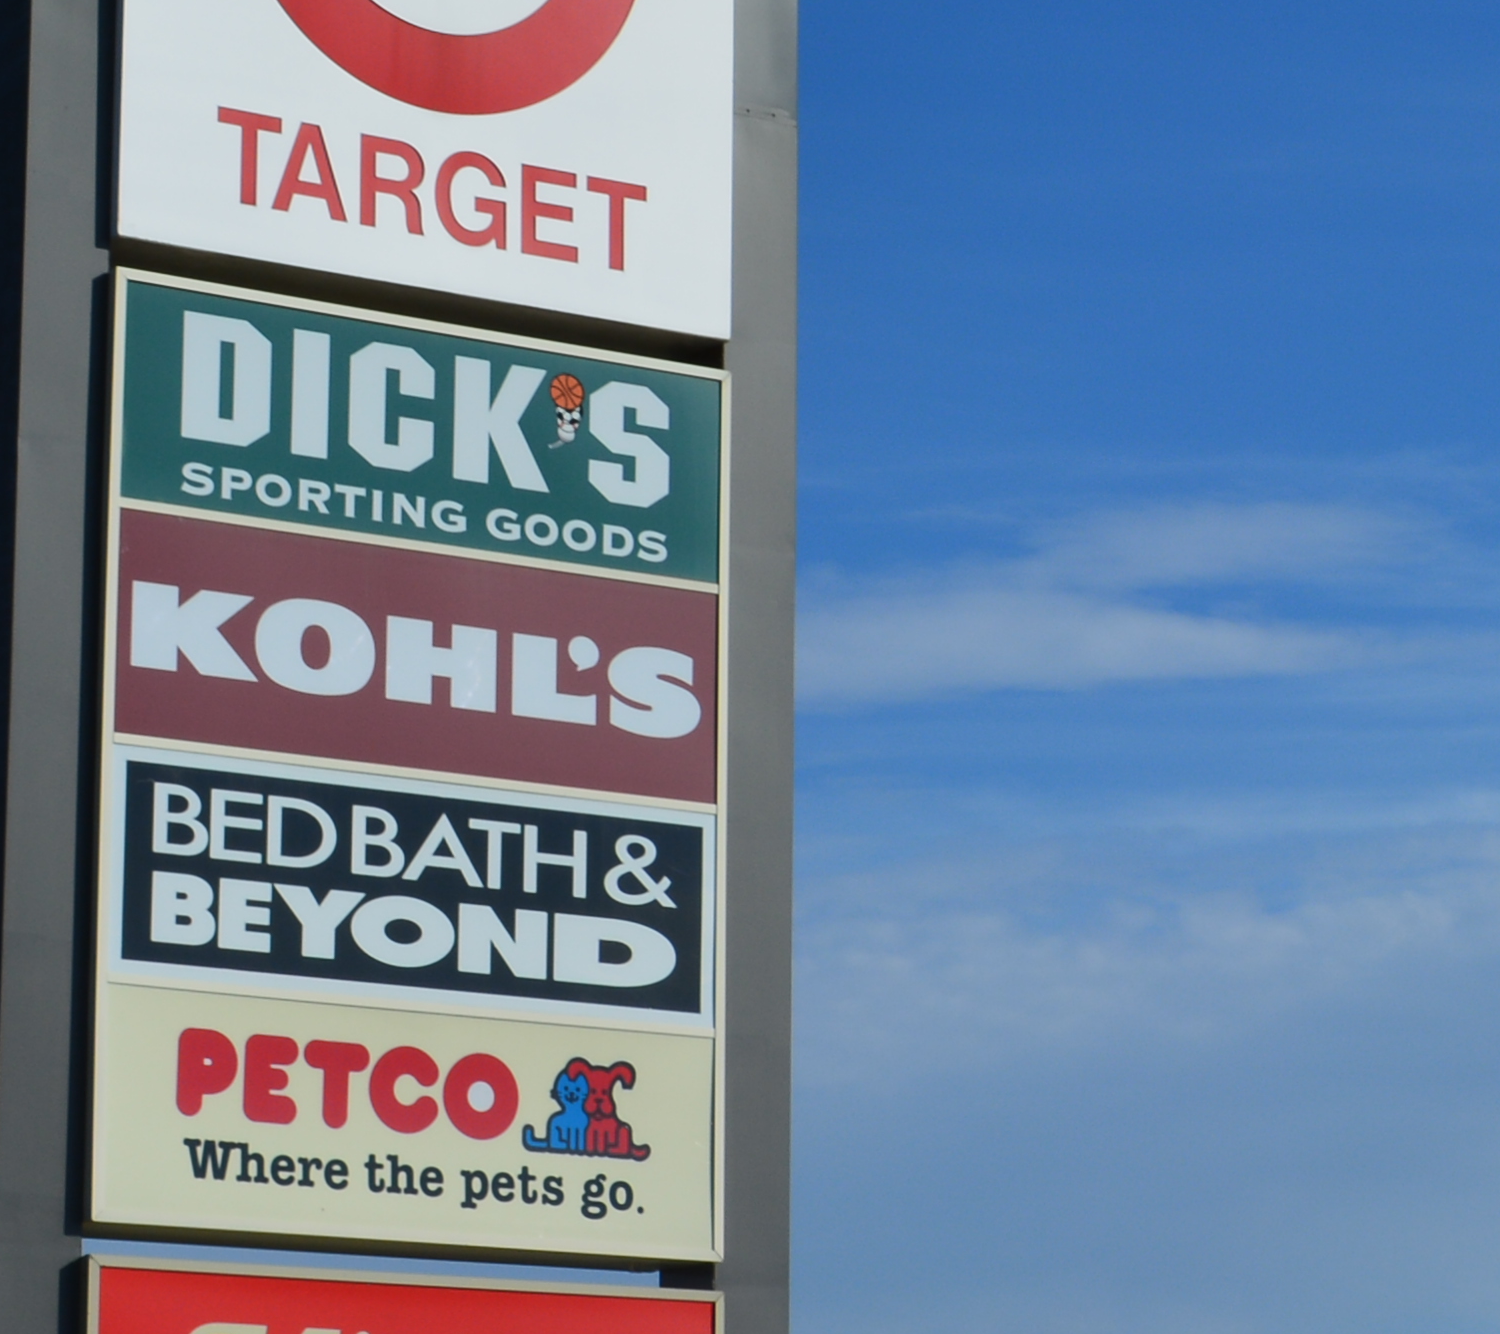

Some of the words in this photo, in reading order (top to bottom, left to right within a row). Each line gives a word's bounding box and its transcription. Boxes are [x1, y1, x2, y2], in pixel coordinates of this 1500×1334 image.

[217, 106, 648, 272] TARGET
[180, 310, 671, 509] DICK'S
[180, 461, 468, 534] SPORTING
[486, 508, 669, 563] GOODS
[130, 580, 702, 740] KOHL'S
[151, 781, 338, 869] BED
[351, 805, 588, 899] BATH
[603, 834, 678, 909] &
[150, 870, 678, 989] BEYOND
[176, 1027, 520, 1141] PETCO
[183, 1138, 350, 1190] Where
[365, 1153, 445, 1198] the
[460, 1165, 565, 1209] pets
[581, 1174, 646, 1220] go.
